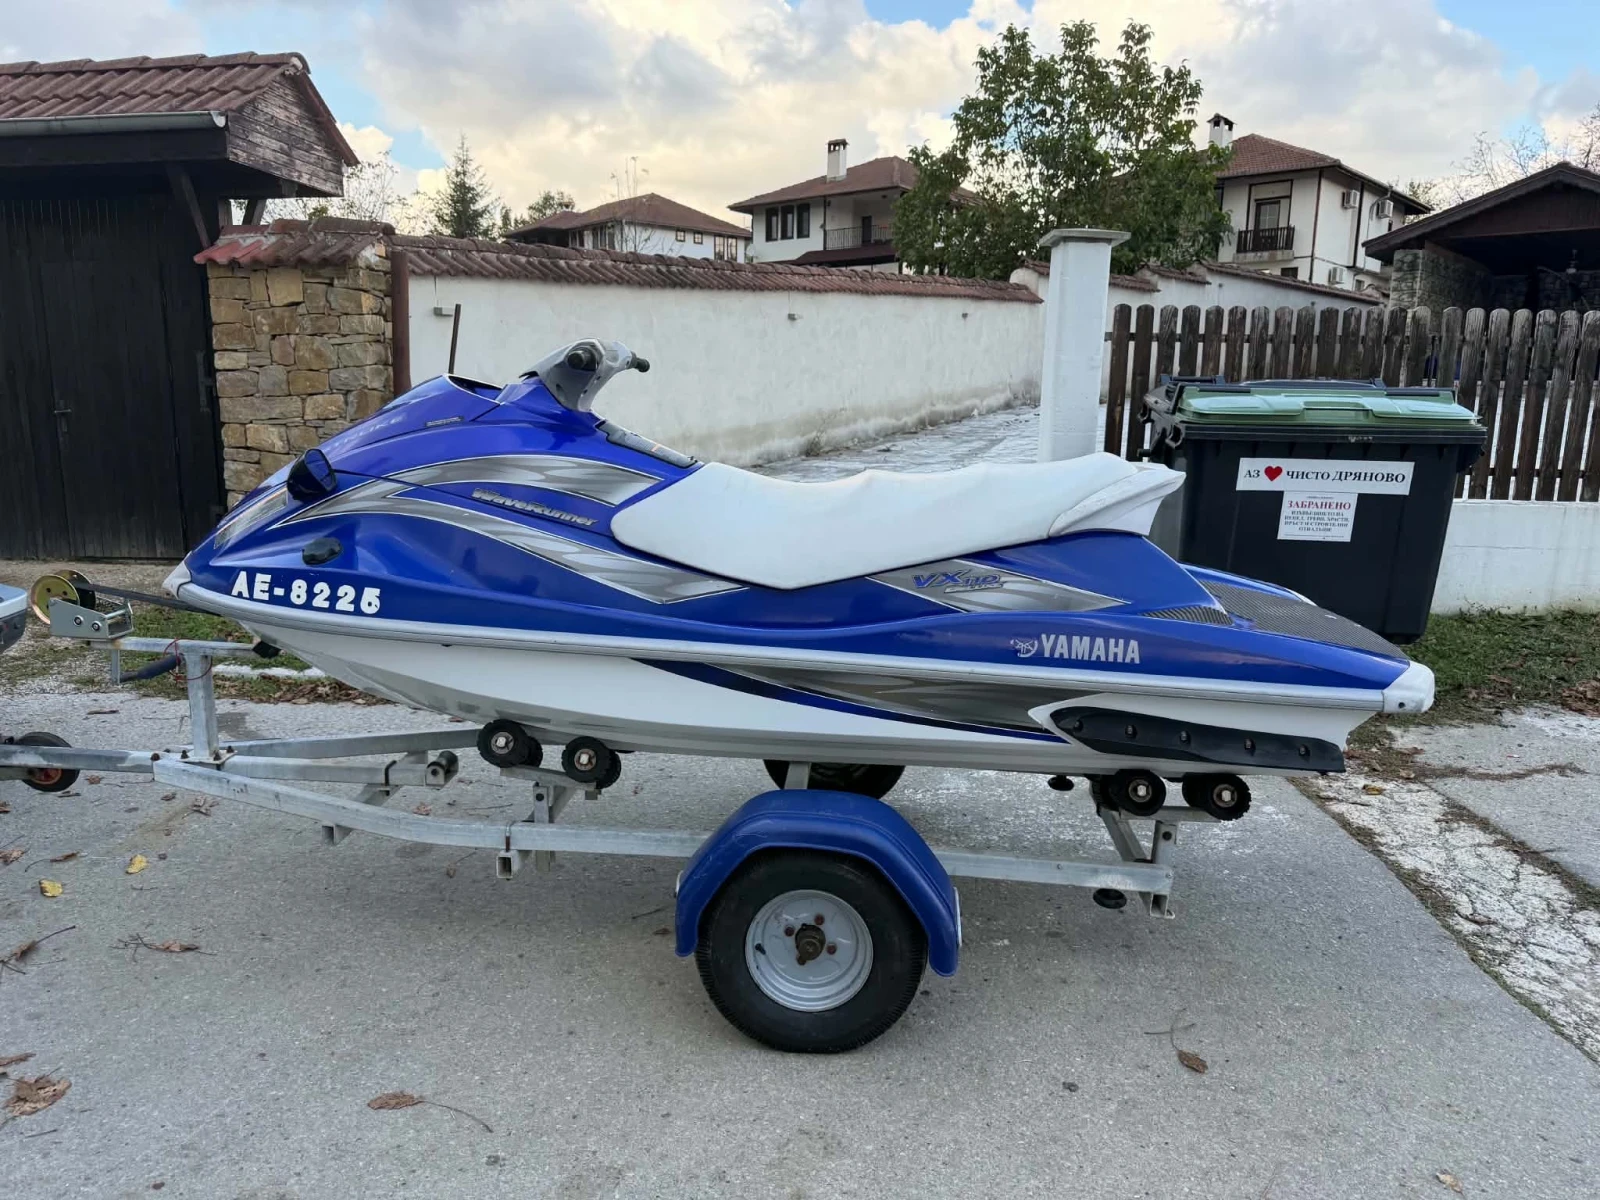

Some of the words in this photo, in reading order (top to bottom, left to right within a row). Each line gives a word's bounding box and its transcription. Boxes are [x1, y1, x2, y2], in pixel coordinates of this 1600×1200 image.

[1243, 469, 1261, 479] АЗ
[1286, 470, 1330, 481] ЧИСТО
[1332, 471, 1406, 483] ДРЯНОВО
[471, 487, 598, 526] WaveRunner
[1287, 500, 1351, 510] ЗАБРАНЕНО
[1041, 633, 1140, 664] YAMAHA
